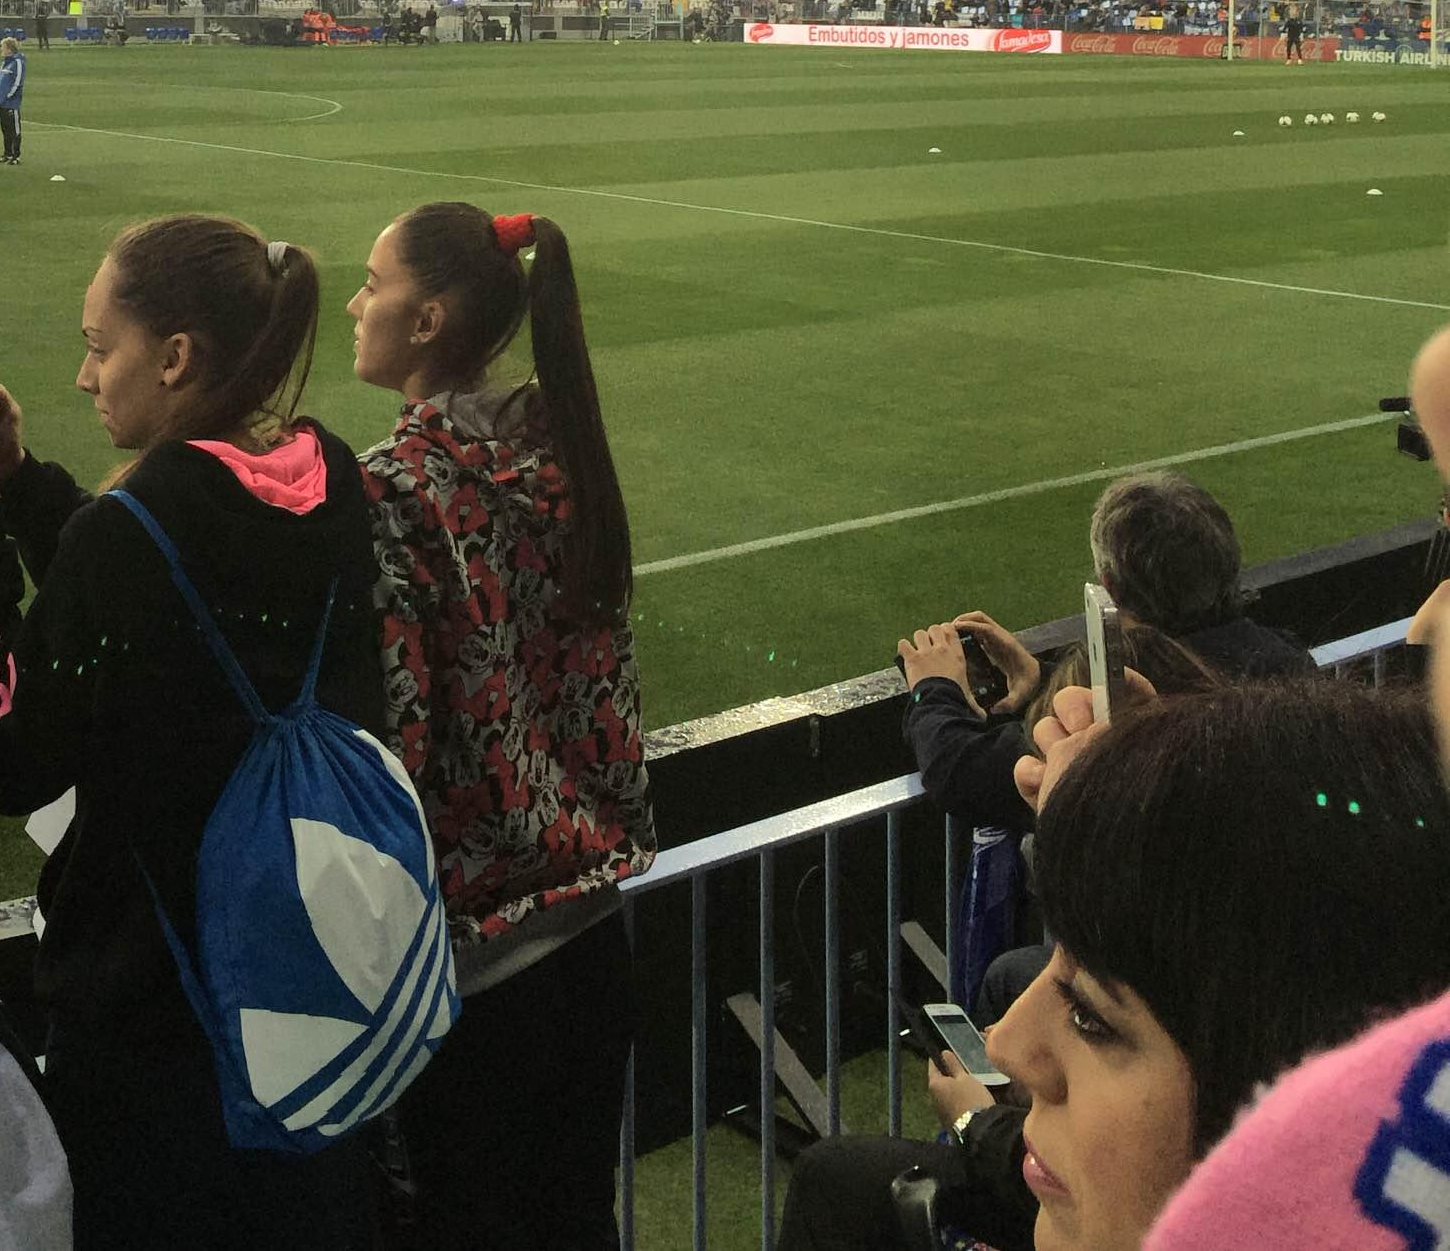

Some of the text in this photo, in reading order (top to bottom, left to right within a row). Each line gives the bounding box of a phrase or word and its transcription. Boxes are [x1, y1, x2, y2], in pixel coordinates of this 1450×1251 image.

[809, 26, 969, 47] Embutidos y jamones
[1334, 49, 1395, 63] TURKISH
